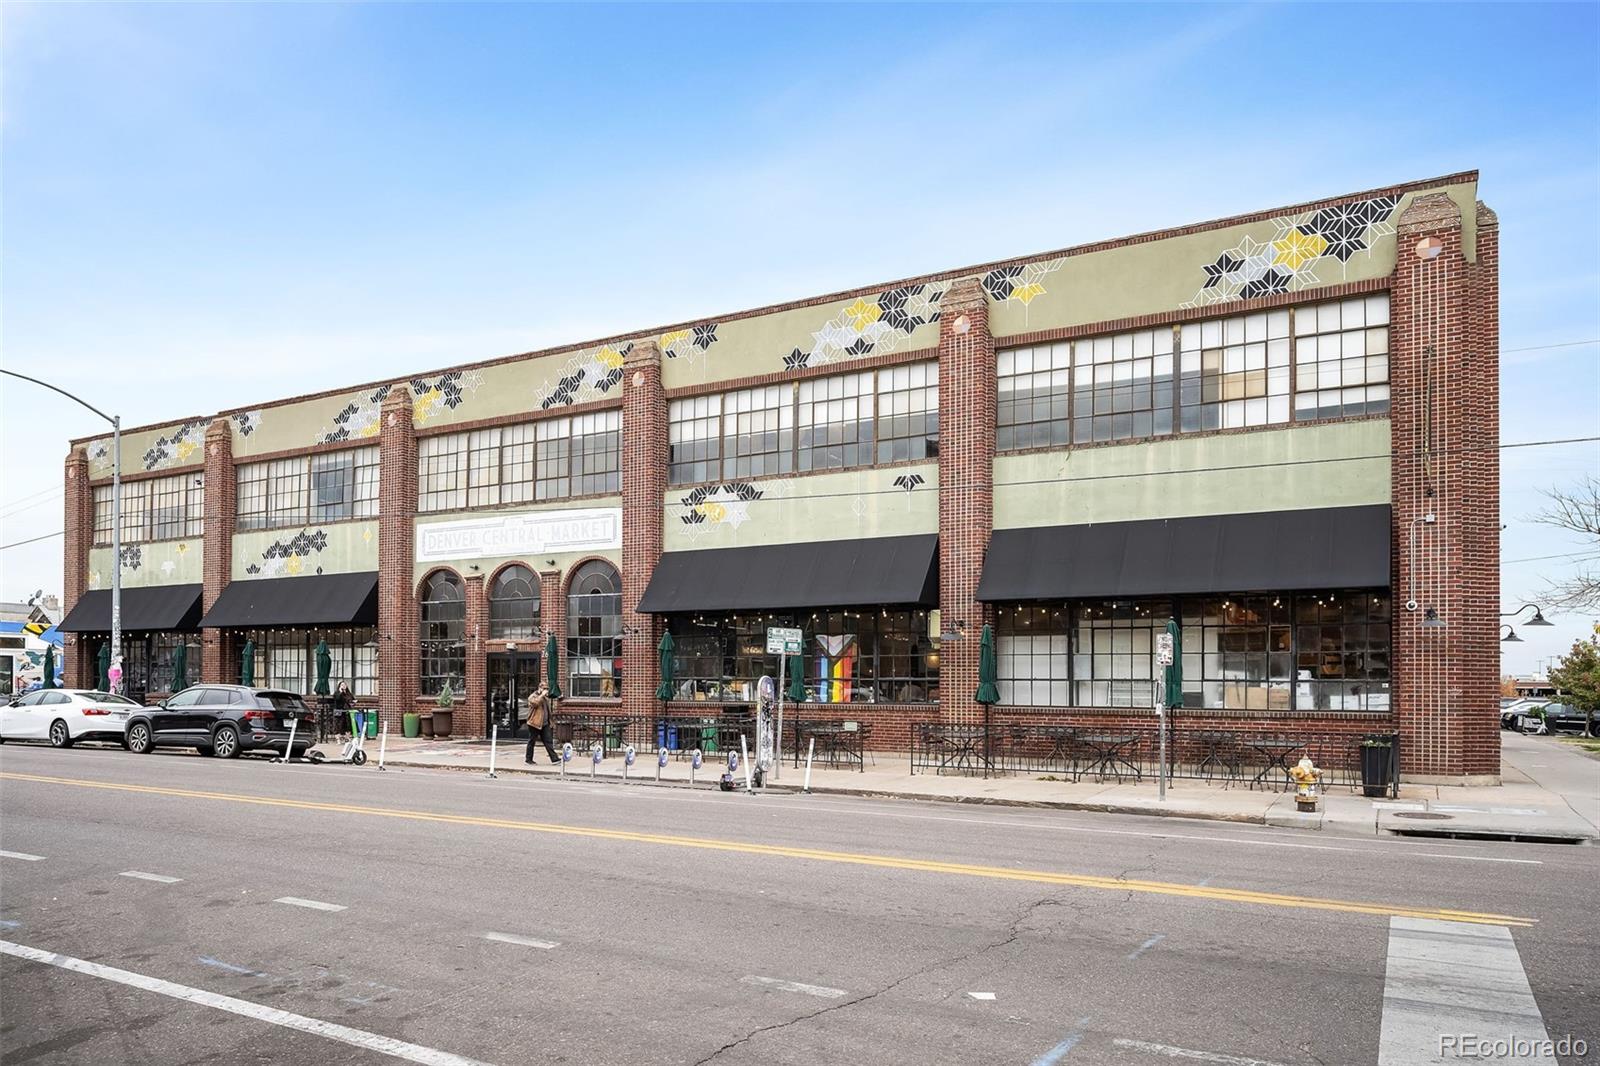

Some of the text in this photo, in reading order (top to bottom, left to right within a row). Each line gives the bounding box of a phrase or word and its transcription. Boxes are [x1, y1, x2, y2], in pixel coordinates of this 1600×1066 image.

[428, 519, 609, 549] DENVER CENTRAL MARKET
